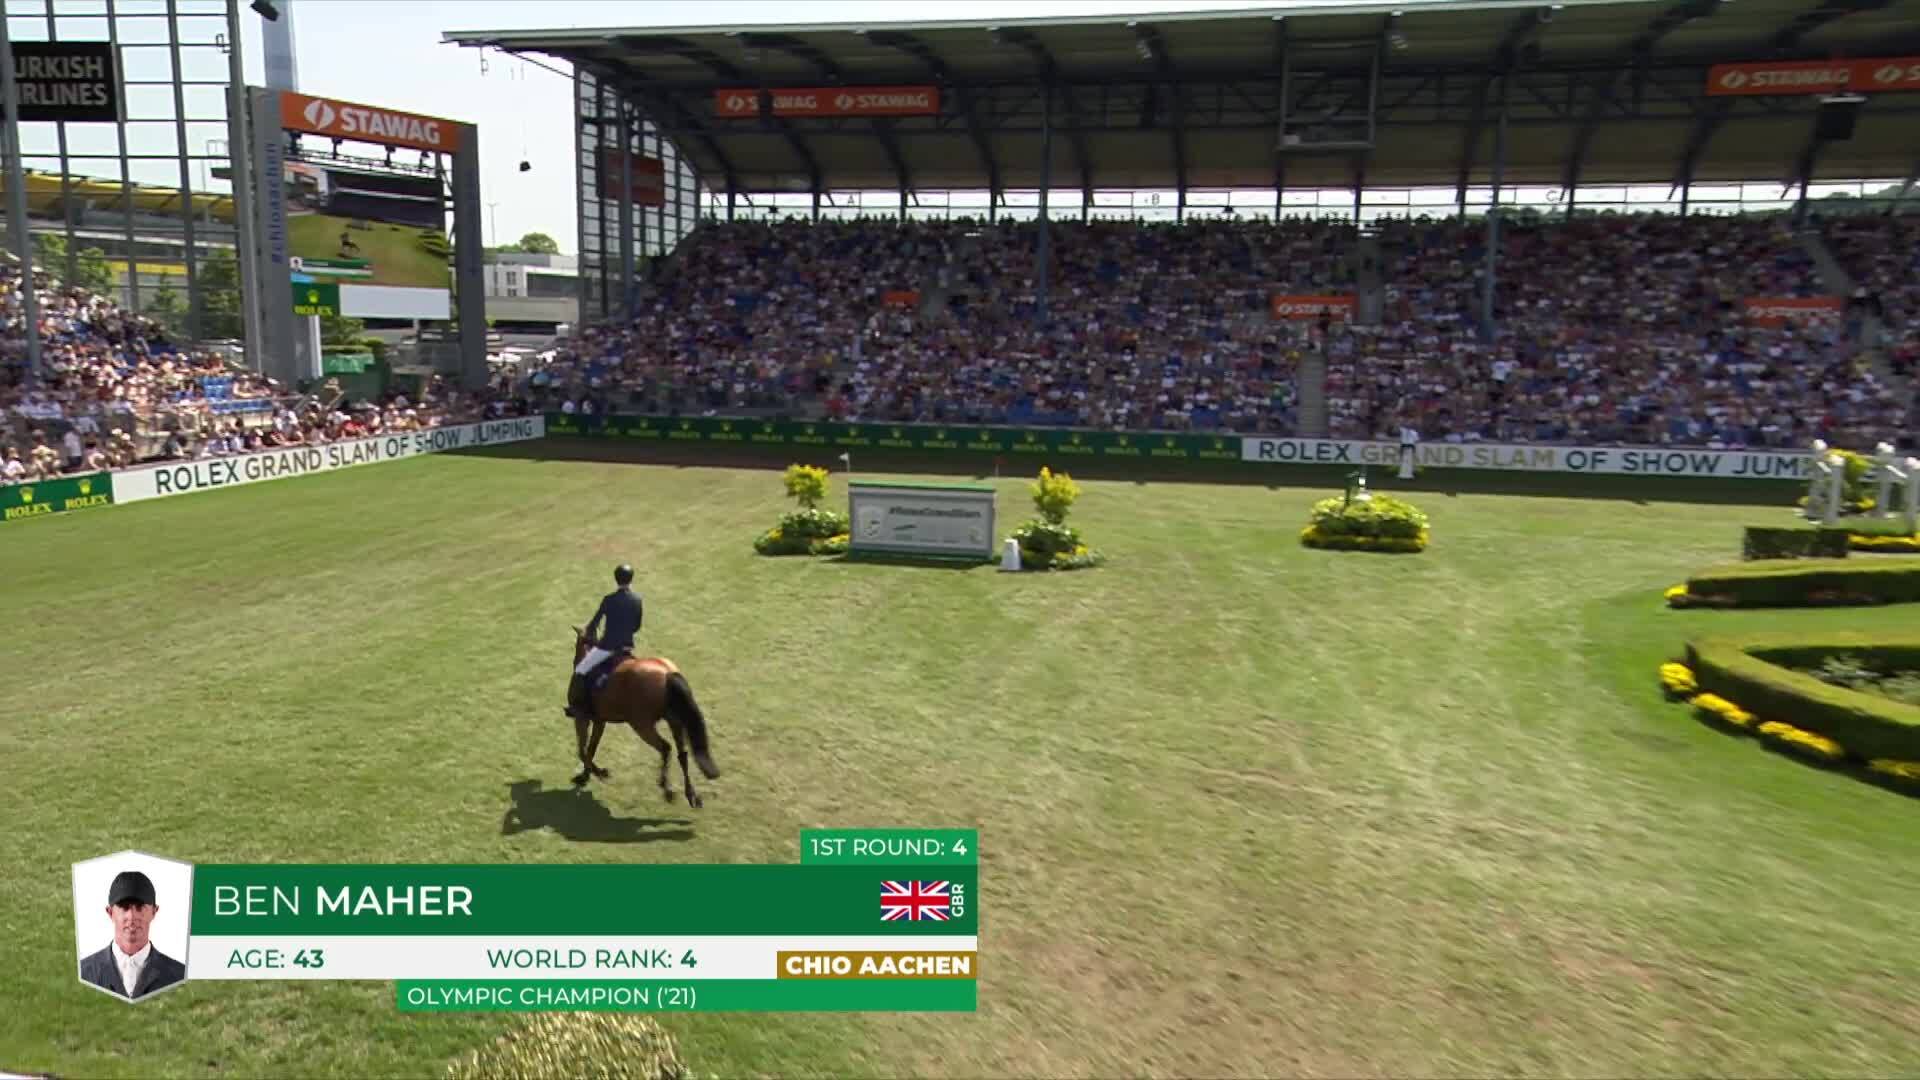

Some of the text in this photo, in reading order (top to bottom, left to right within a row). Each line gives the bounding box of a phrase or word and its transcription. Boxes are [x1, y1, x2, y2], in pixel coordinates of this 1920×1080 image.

[15, 56, 104, 79] URKISH
[16, 83, 107, 106] IRLINES
[341, 107, 441, 144] STAWAG
[155, 459, 240, 494] ROLEX
[245, 449, 322, 480] GRAND
[329, 442, 378, 467] SLAM
[386, 437, 409, 458] OF
[416, 429, 461, 453] SHOW
[470, 420, 532, 444] JUMPING
[1259, 440, 1351, 462] ROLEX
[1472, 447, 1555, 467] SLAM
[1565, 450, 1609, 470] OF
[1621, 451, 1721, 473] SHOW
[5, 502, 52, 521] ROLEX
[65, 494, 109, 510] ROLEX
